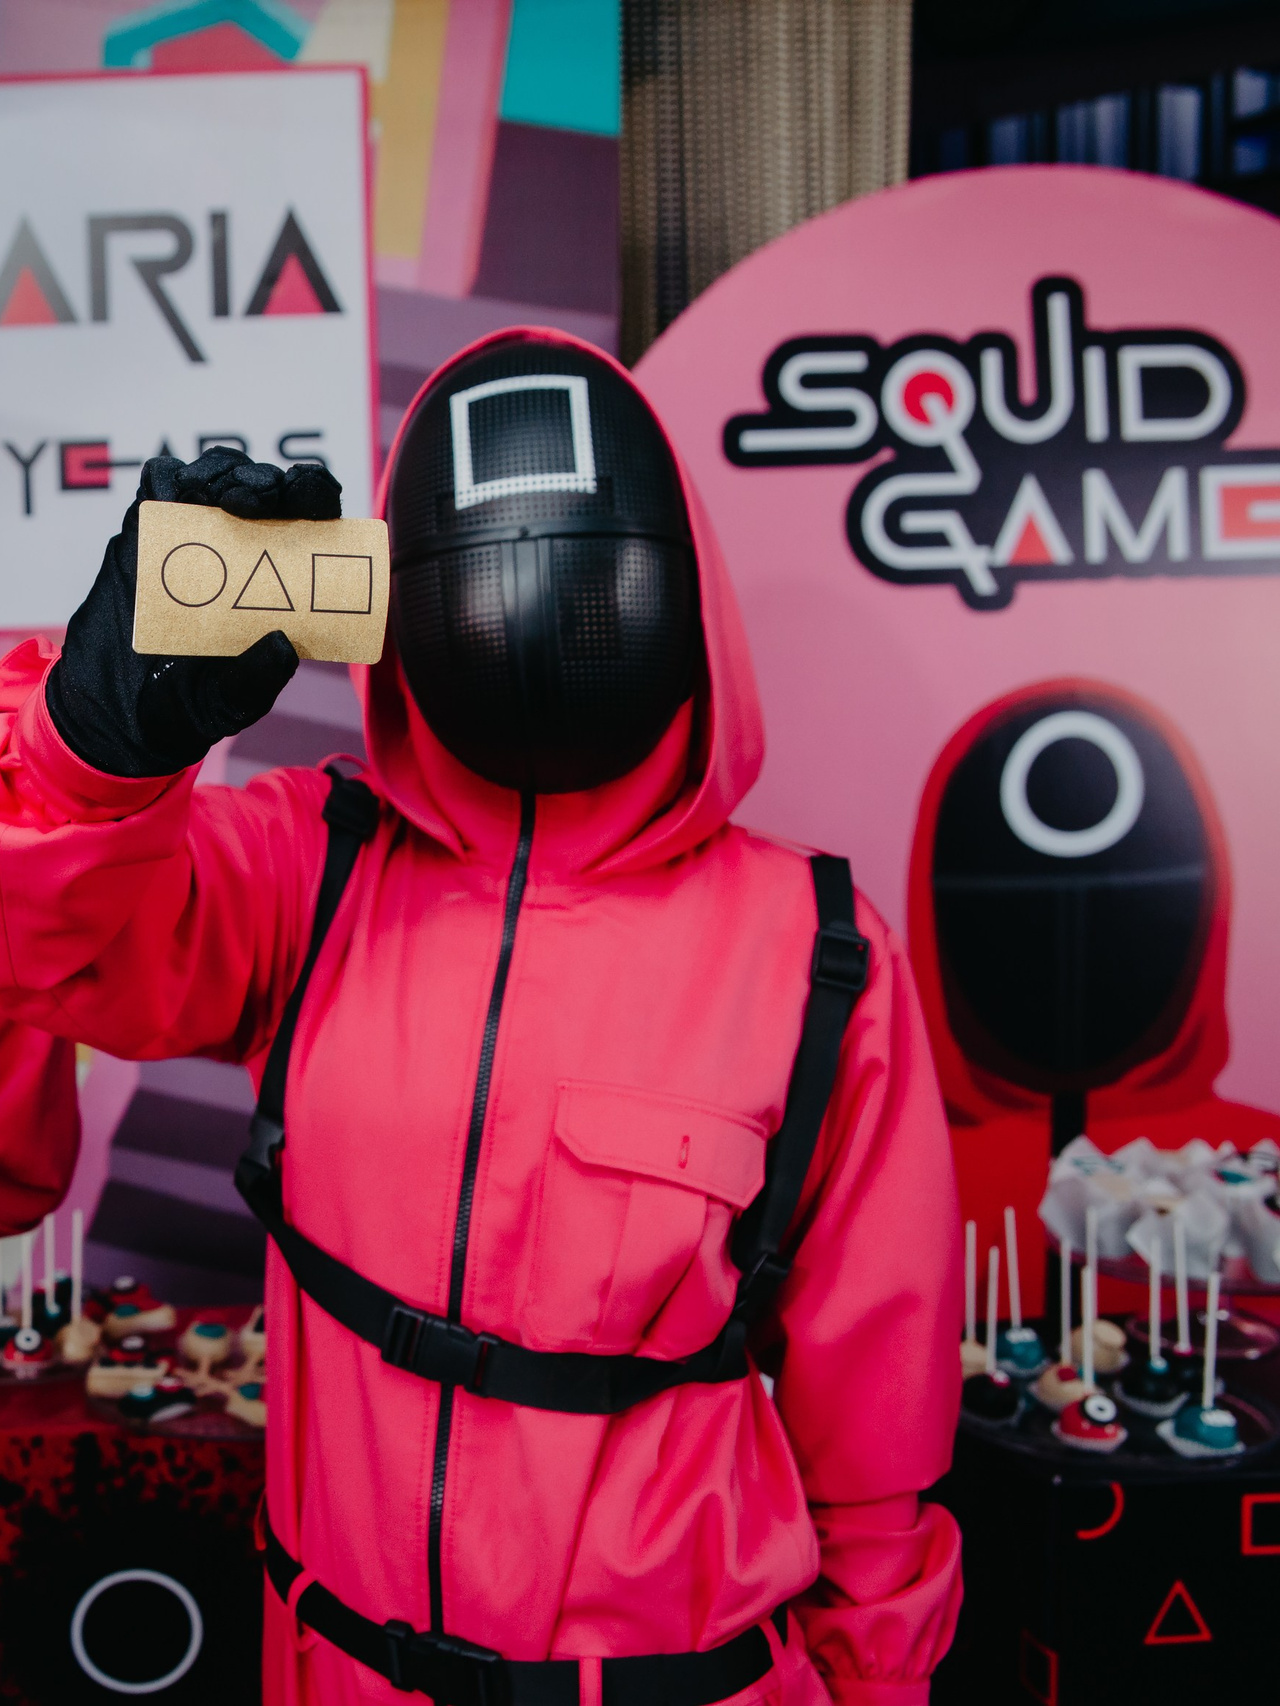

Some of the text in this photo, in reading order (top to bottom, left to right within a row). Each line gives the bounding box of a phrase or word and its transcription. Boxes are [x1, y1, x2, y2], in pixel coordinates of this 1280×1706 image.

[738, 291, 1232, 452] SQUID
[5, 430, 328, 517] YES
[861, 463, 1280, 596] GAME
